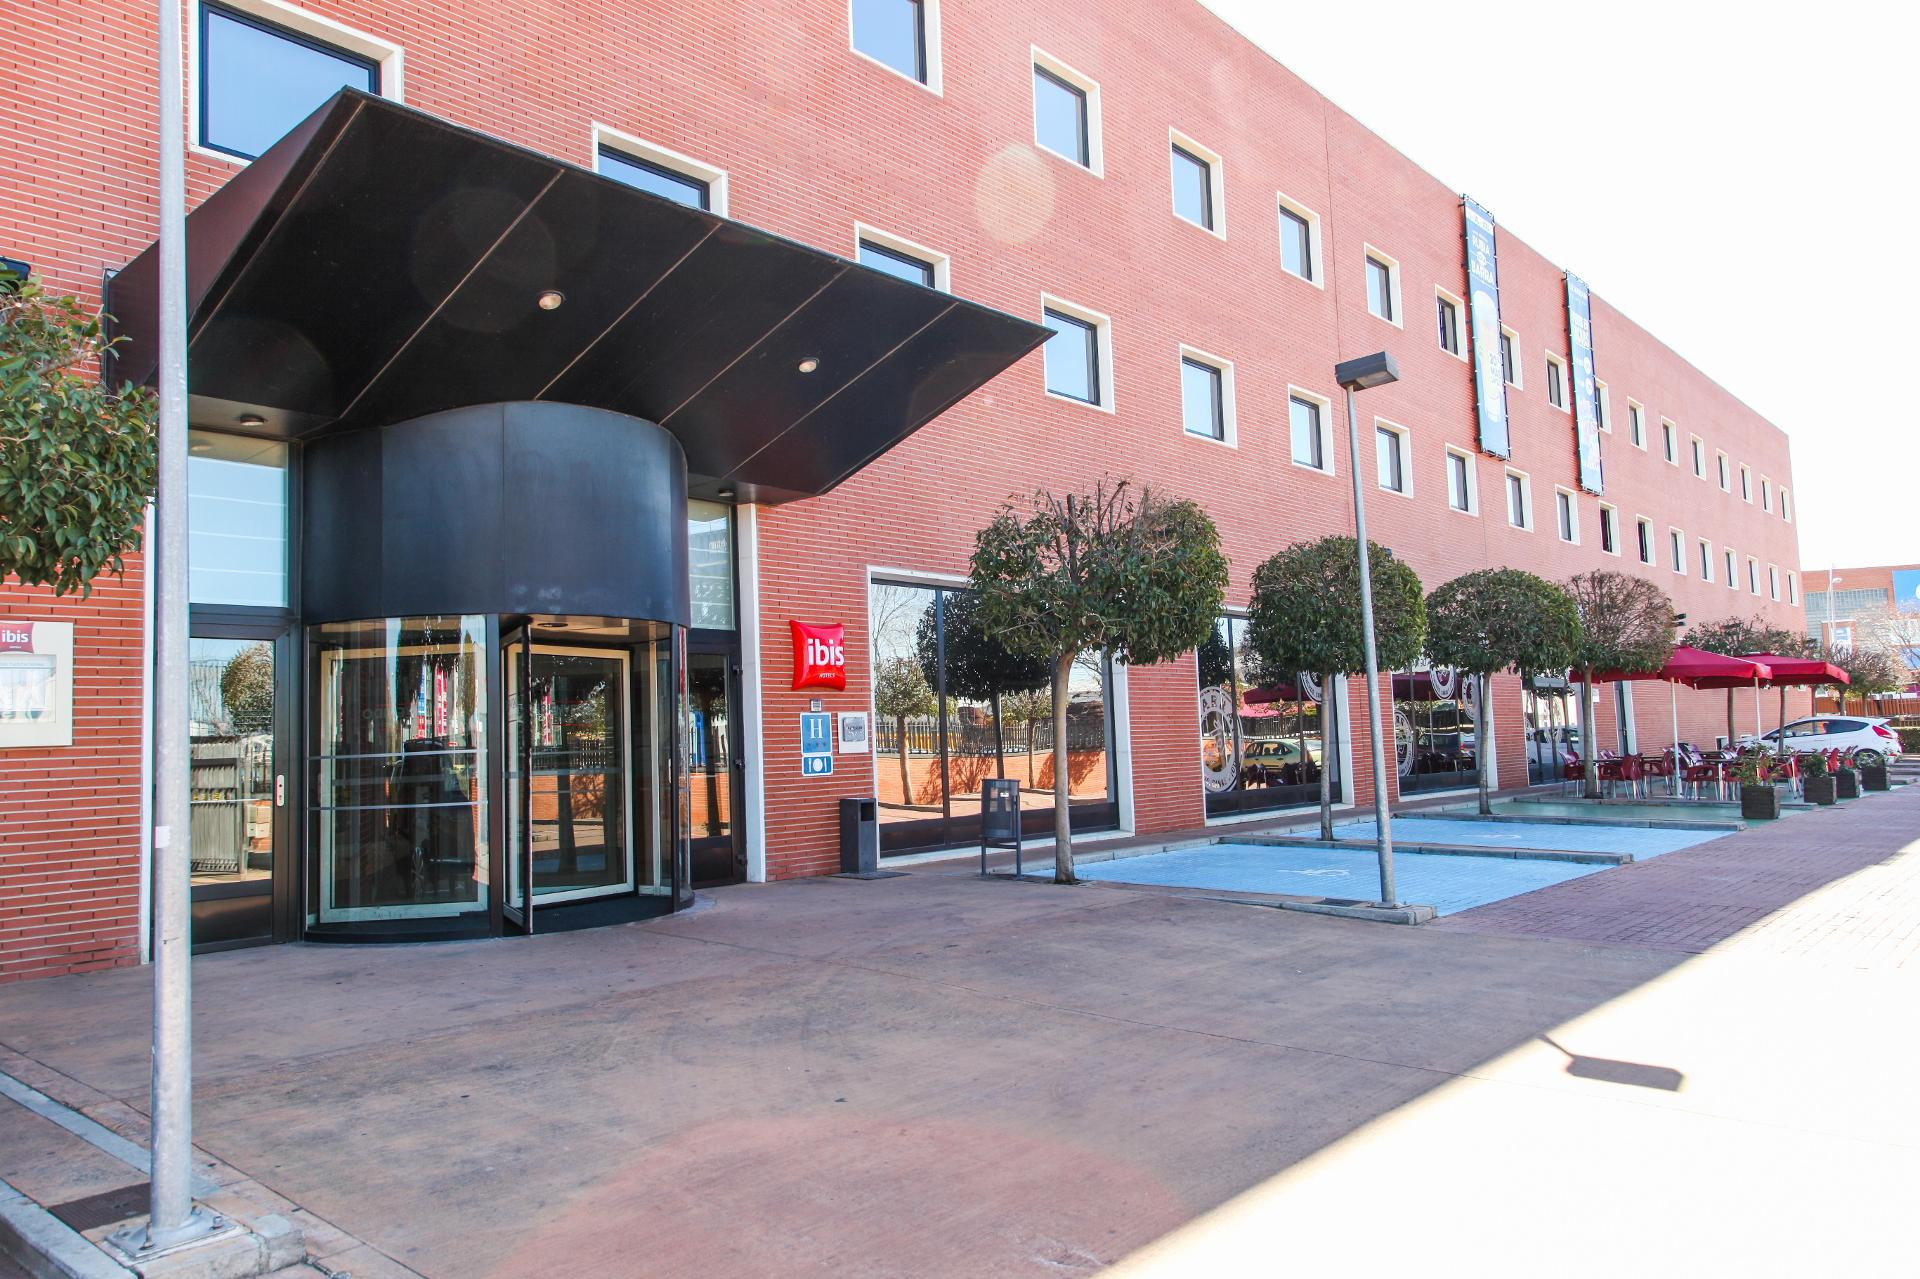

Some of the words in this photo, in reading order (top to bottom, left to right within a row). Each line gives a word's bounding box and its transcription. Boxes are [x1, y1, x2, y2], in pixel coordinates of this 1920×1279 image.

[1471, 260, 1494, 285] BARRA
[2, 630, 29, 642] ibis
[807, 638, 844, 666] ibis
[810, 718, 823, 739] H
